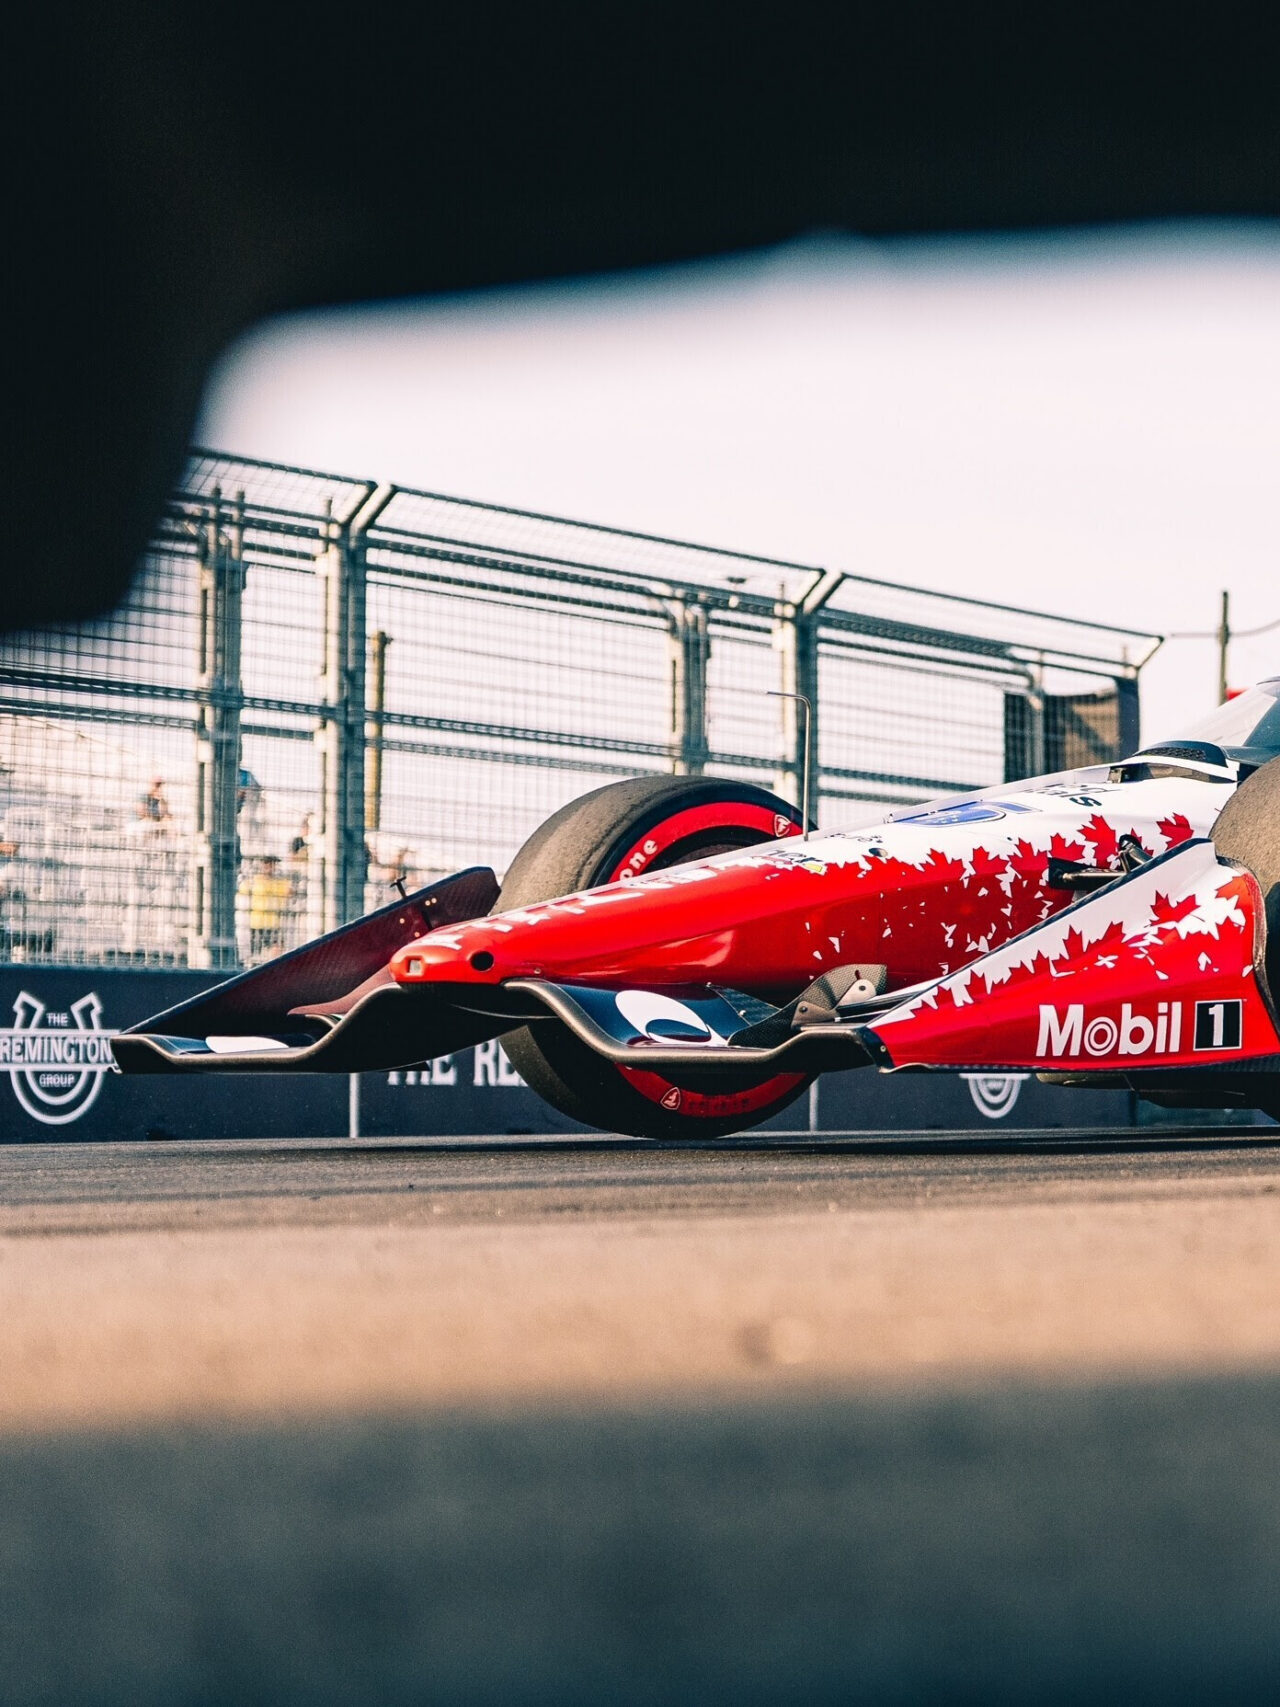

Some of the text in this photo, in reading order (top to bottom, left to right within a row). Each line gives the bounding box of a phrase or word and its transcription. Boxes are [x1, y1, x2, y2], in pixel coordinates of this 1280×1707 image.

[46, 1012, 69, 1026] THE
[1035, 1001, 1182, 1057] Mobil
[0, 1036, 113, 1064] REMINGTON
[39, 1073, 75, 1088] GROUP
